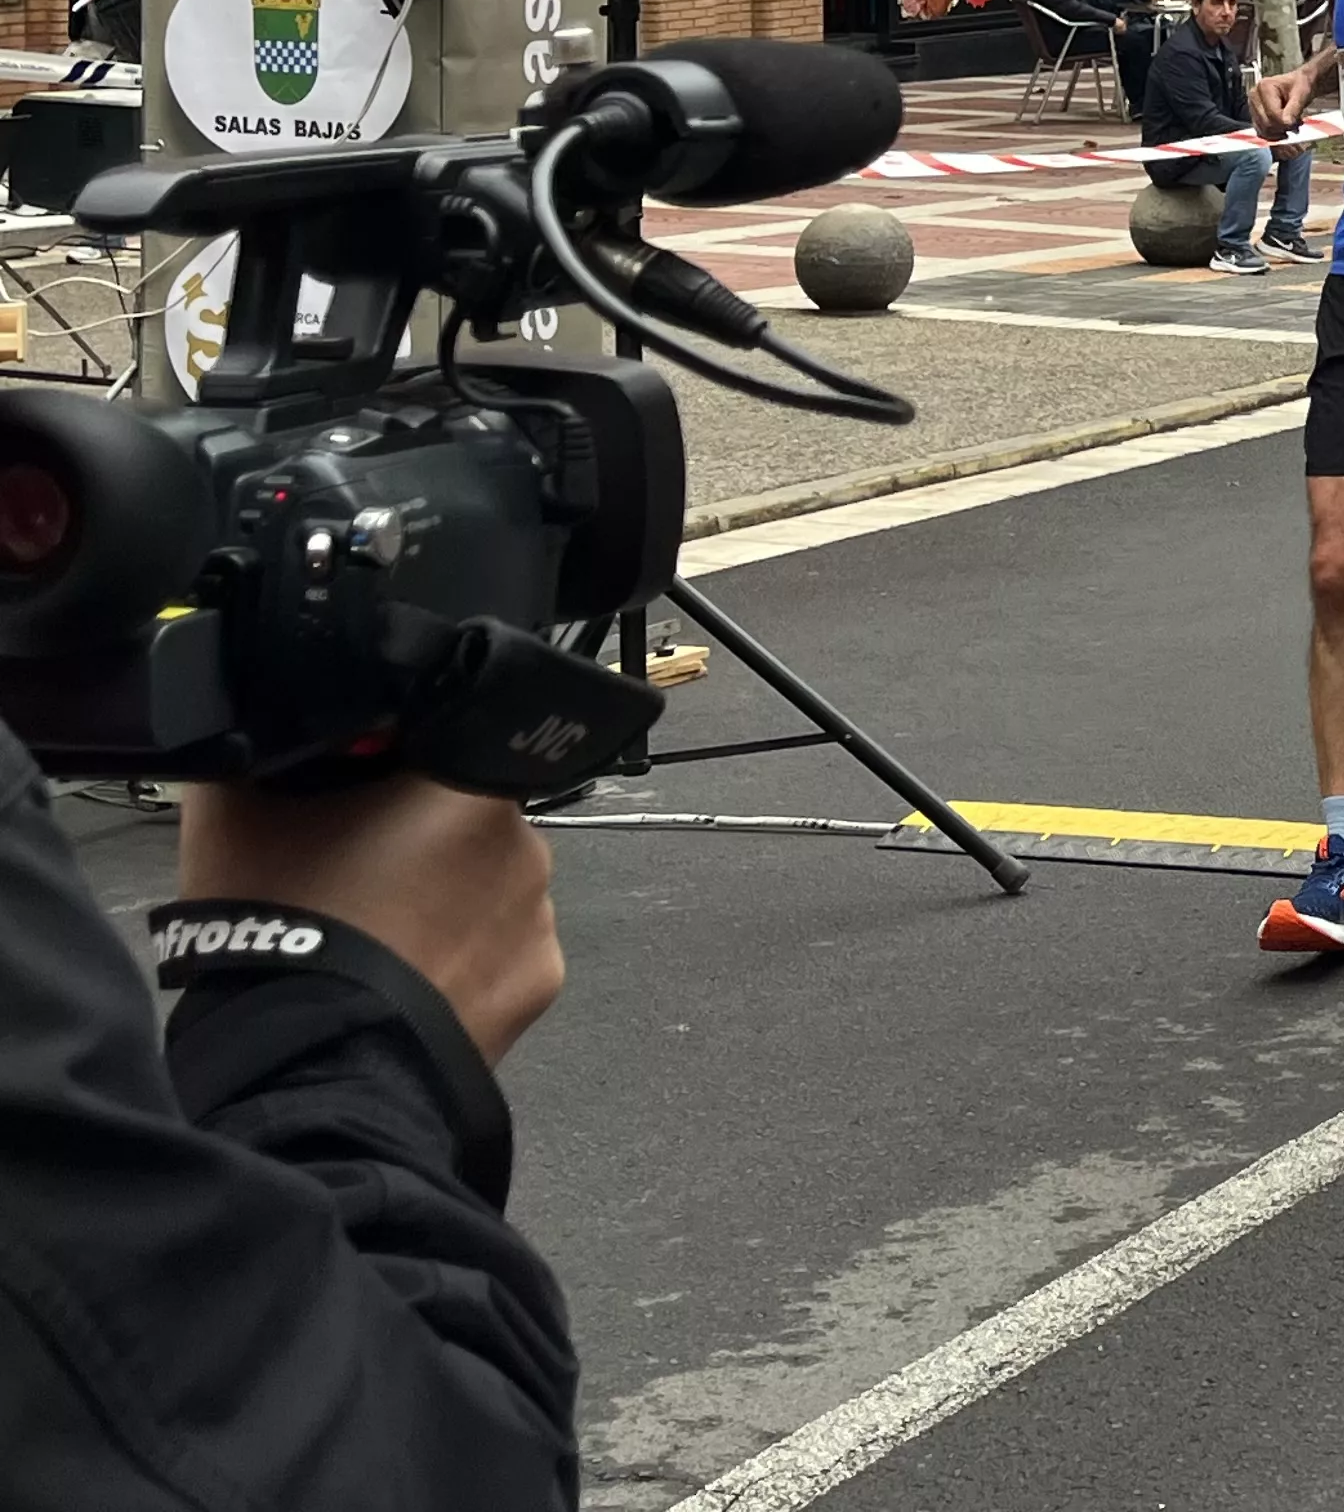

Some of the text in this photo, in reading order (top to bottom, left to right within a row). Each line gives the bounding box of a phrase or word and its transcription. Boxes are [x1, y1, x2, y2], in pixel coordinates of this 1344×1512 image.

[214, 115, 362, 140] SALAS BAJAS
[507, 714, 588, 762] JVC
